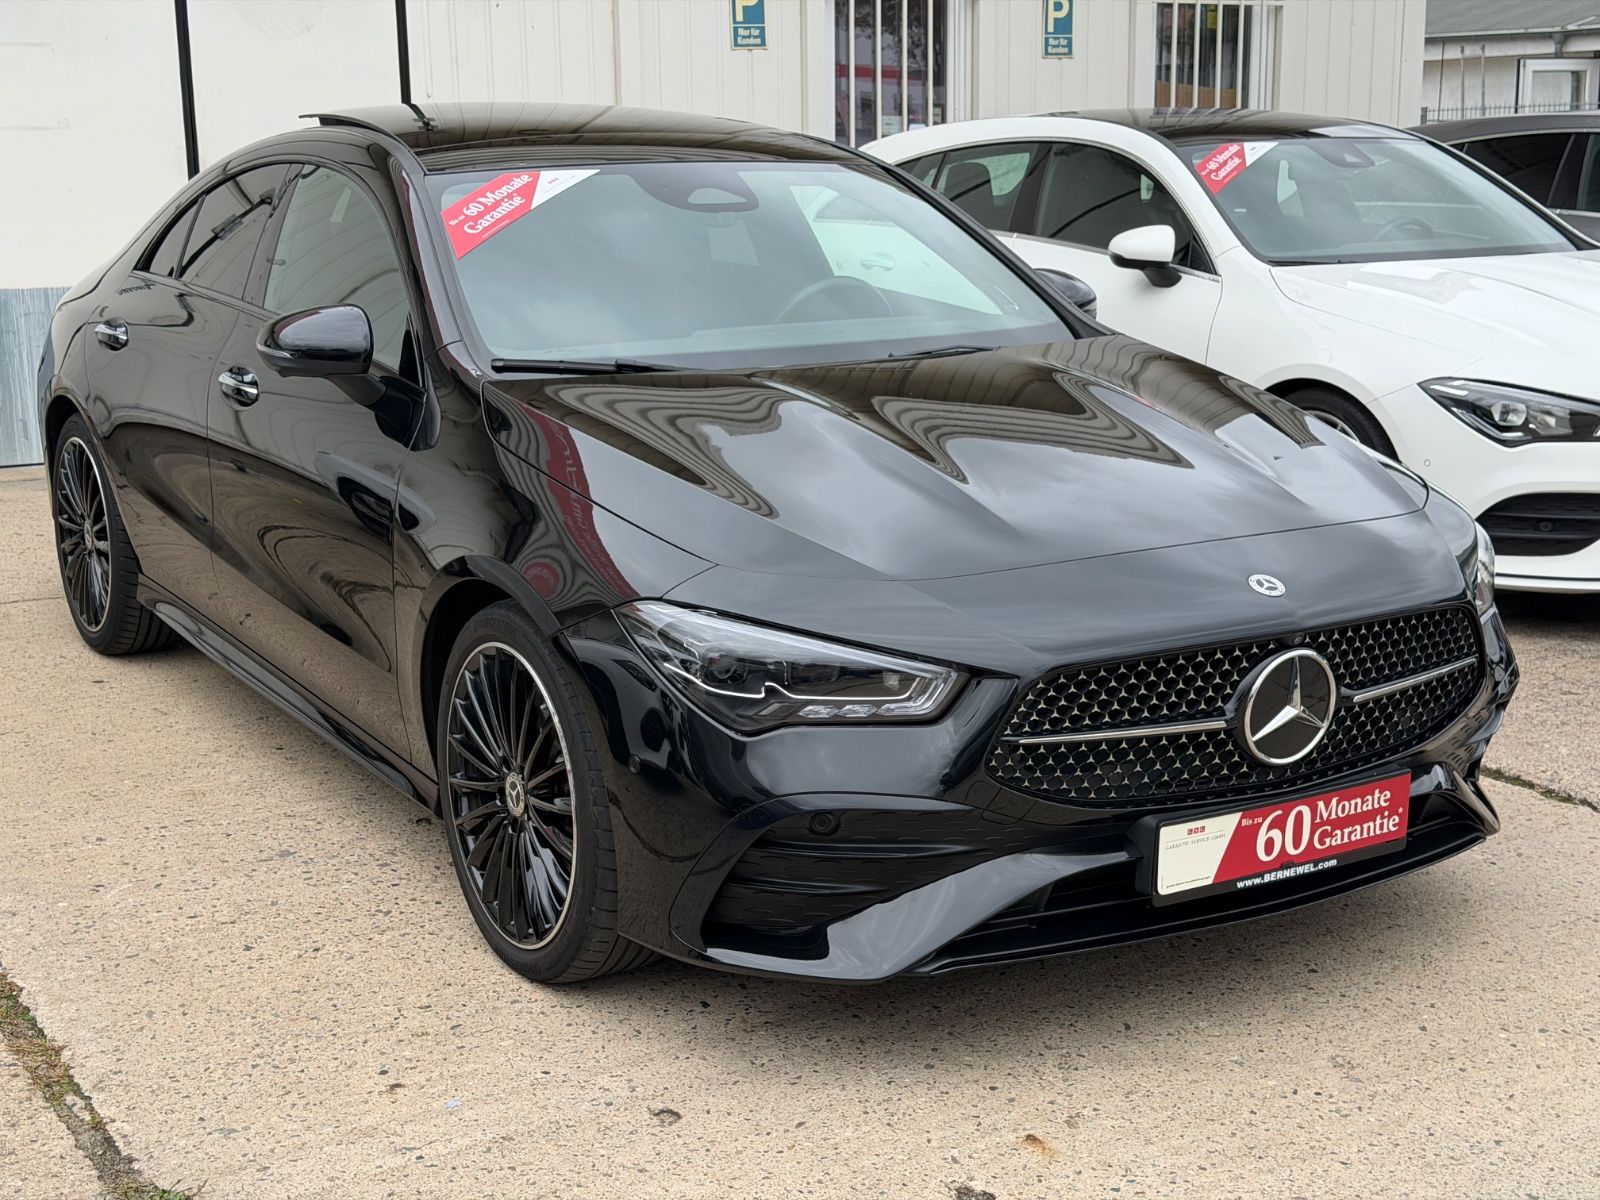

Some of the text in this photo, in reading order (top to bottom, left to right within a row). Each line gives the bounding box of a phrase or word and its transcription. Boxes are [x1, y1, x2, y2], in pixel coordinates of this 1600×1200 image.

[1047, 0, 1070, 33] P
[737, 36, 762, 45] Kunden
[463, 202, 485, 217] 60
[476, 174, 533, 207] Monate
[1241, 788, 1391, 862] Bis zu 60 Monate
[1236, 858, 1338, 889] www.BERNEWEL.com
